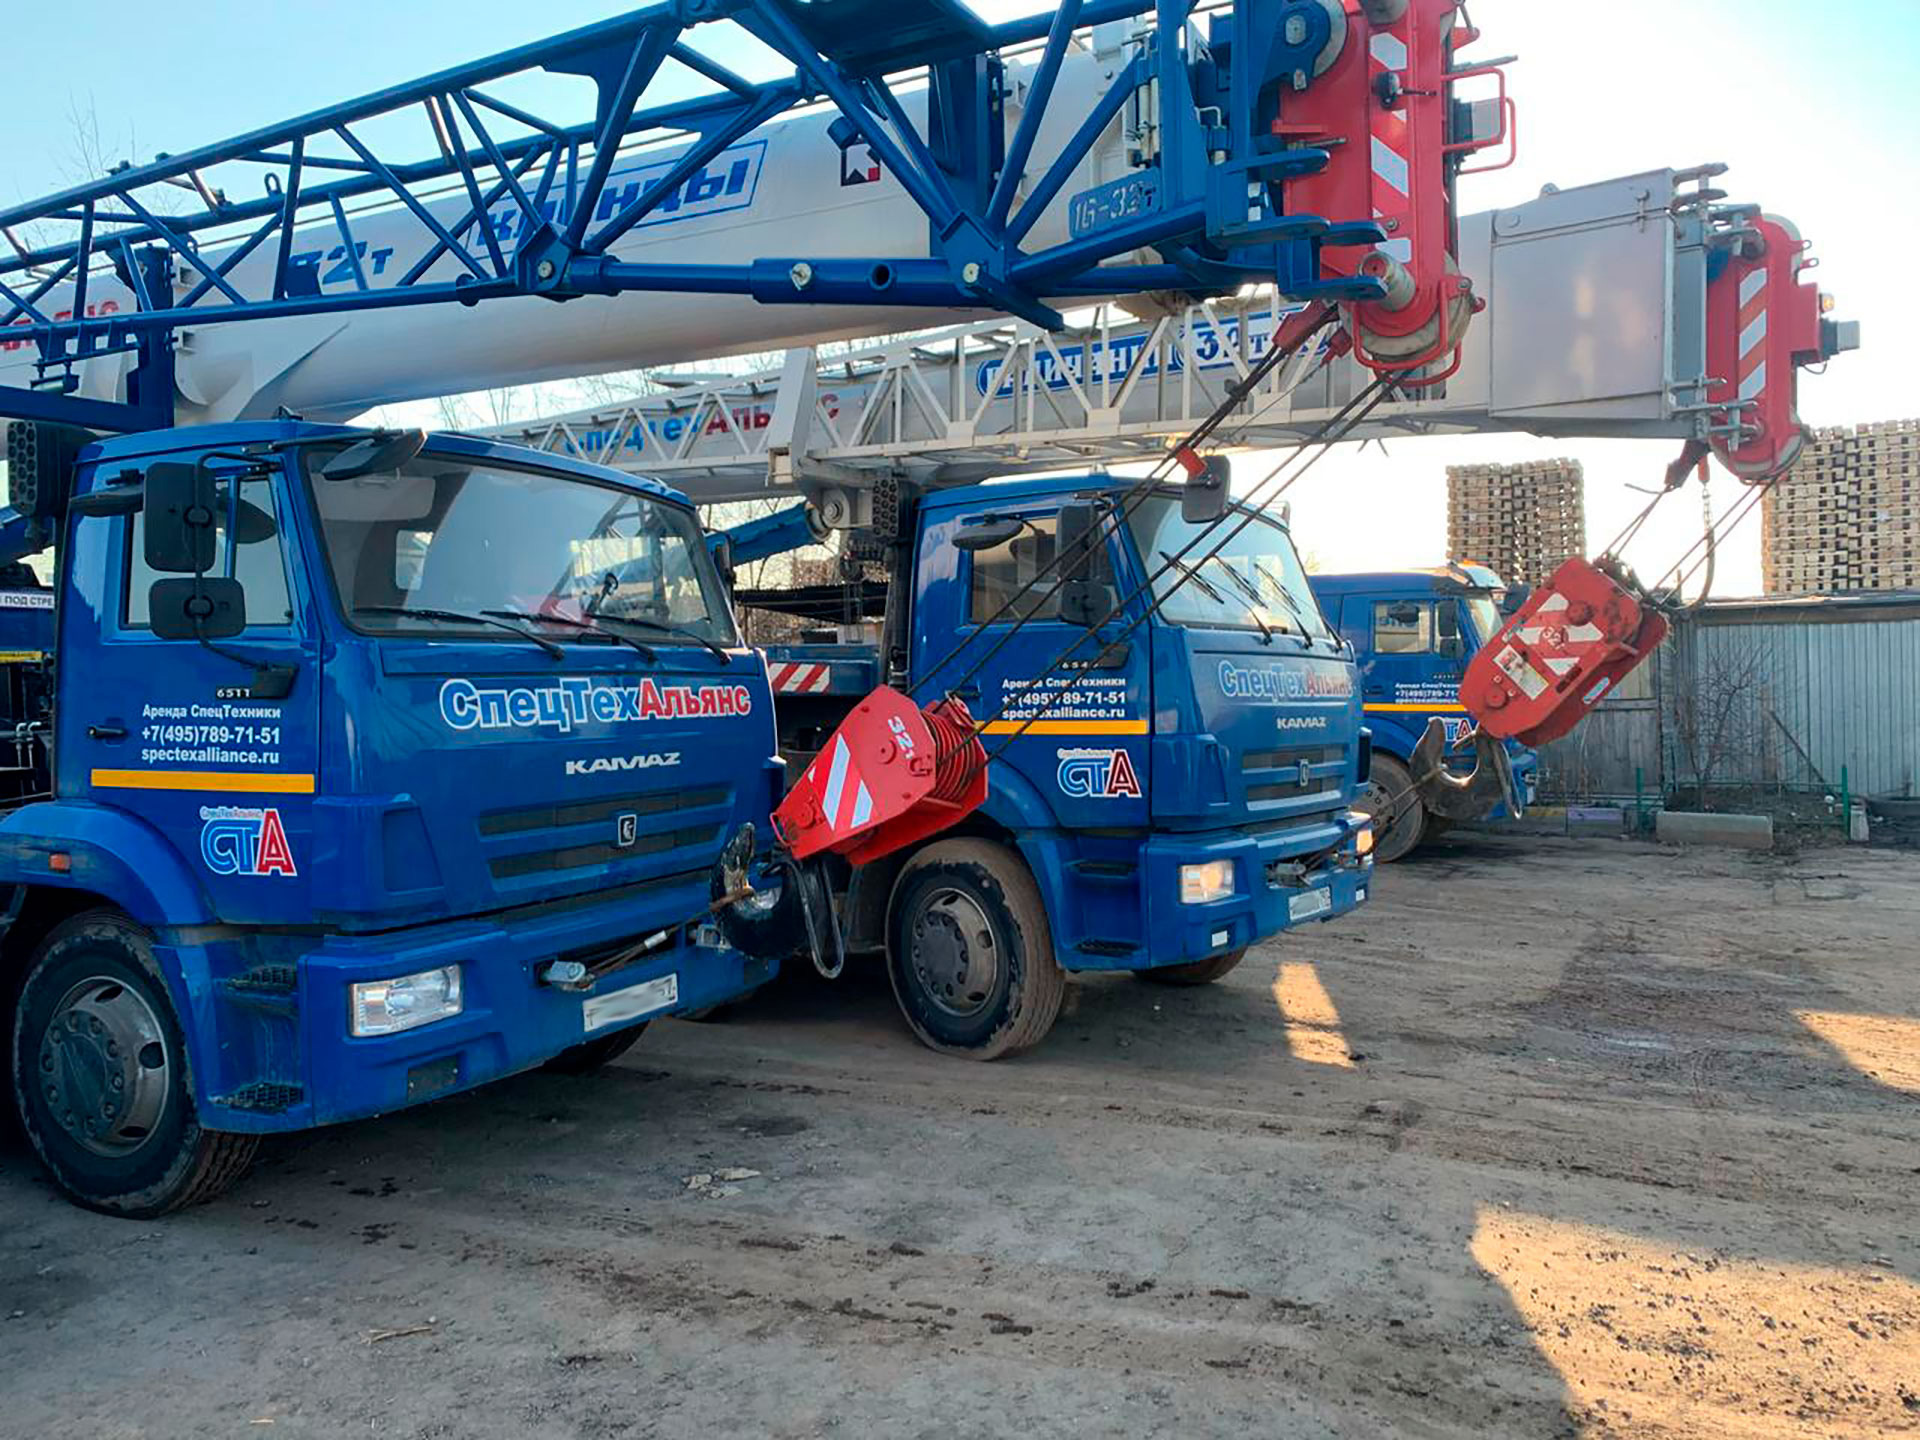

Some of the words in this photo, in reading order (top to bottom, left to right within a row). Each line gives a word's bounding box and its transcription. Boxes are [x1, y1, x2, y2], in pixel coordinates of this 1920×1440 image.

[1002, 678, 1043, 691] Арена
[142, 704, 188, 720] Аренда
[190, 704, 281, 720] СпецТехники
[439, 678, 751, 732] СпецТехАльянс
[1276, 717, 1328, 729] KAMAZ
[141, 725, 281, 747] +7(495)789-71-51
[141, 746, 280, 764] spectexalliance.ru
[565, 752, 681, 775] KAMAZ
